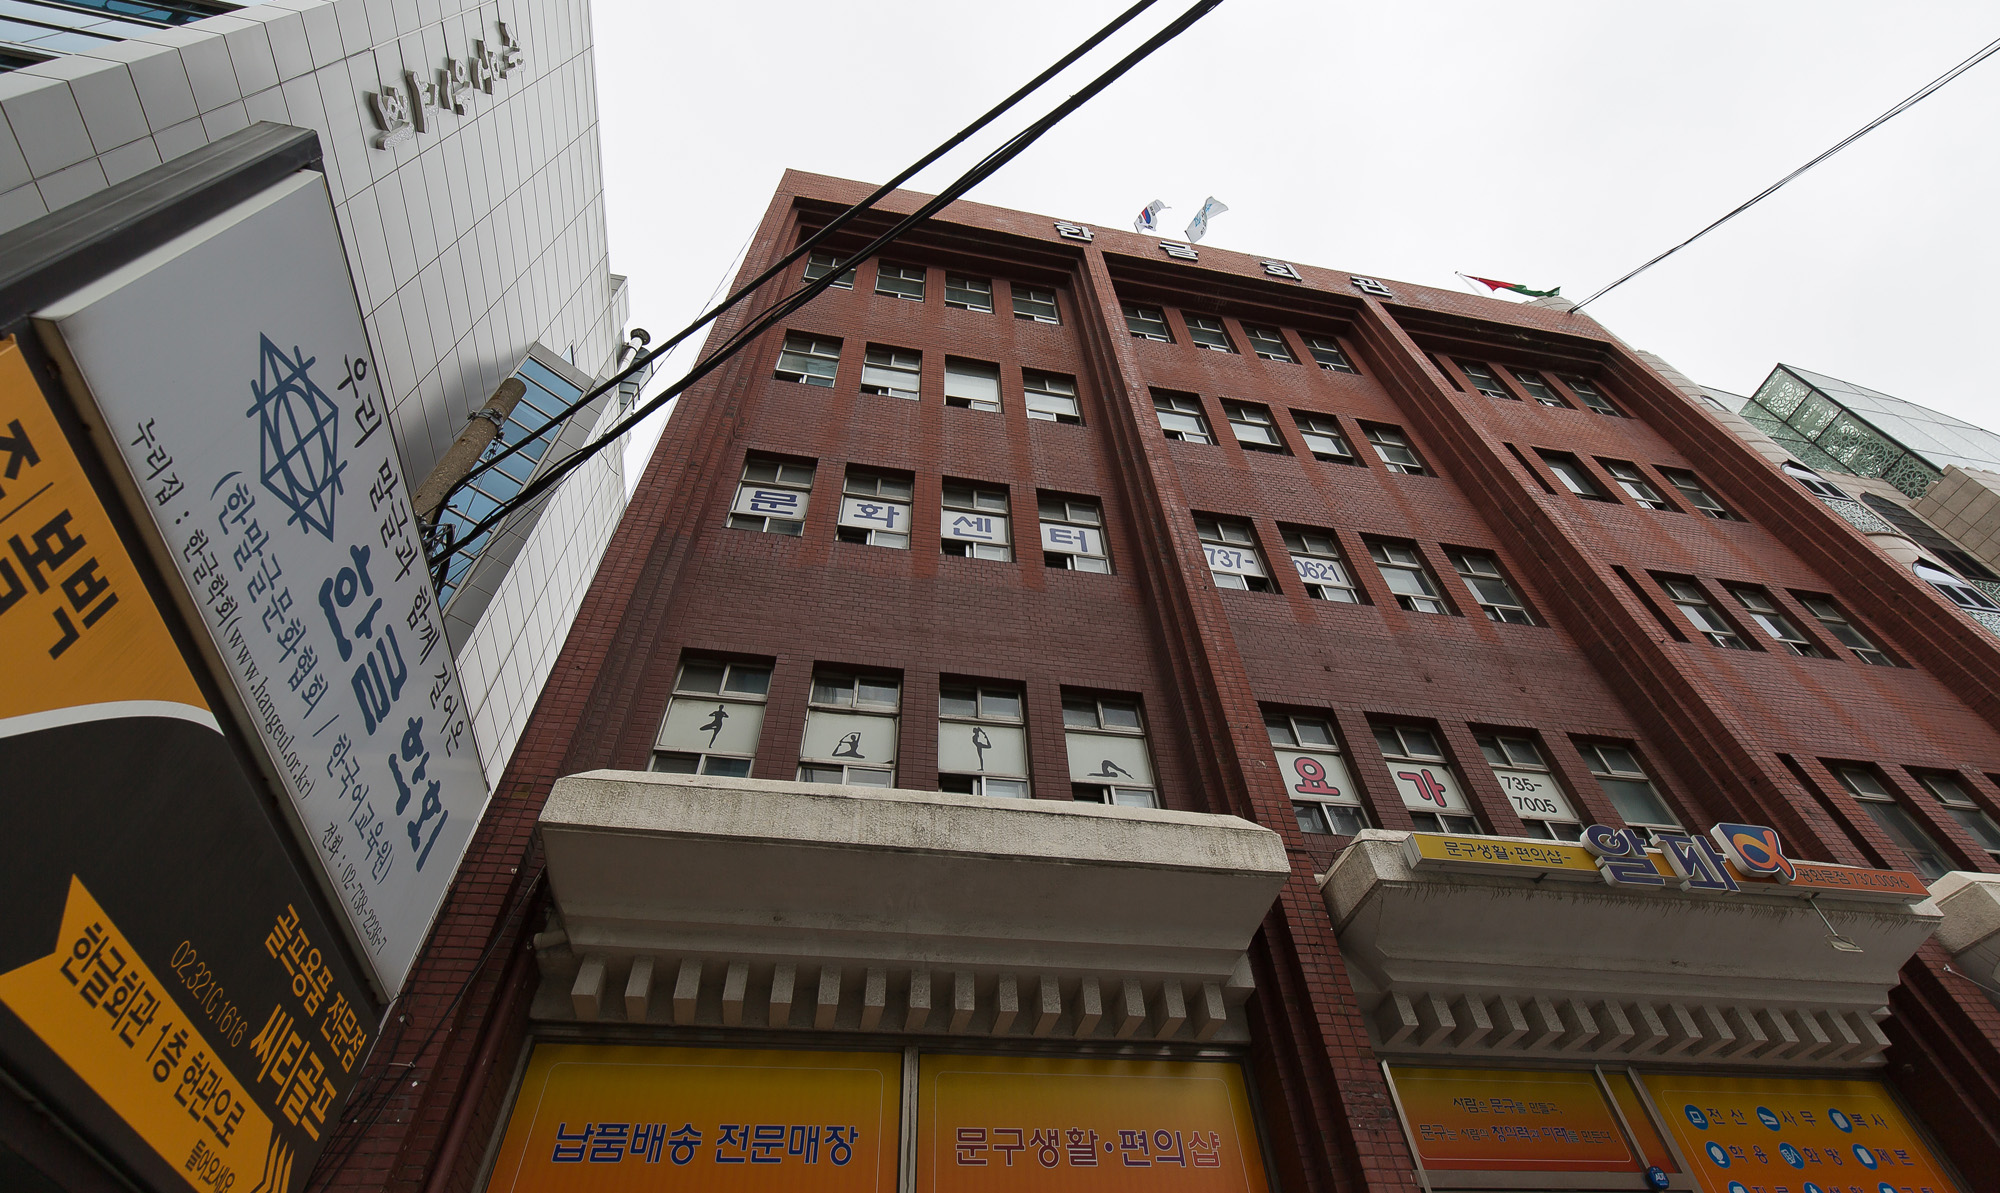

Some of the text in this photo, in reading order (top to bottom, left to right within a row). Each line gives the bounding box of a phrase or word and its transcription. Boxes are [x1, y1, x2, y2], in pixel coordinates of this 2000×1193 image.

[369, 21, 527, 151] 새문안교회
[1054, 220, 1393, 298] 한글회관
[337, 353, 465, 758] 우리 말글과 함께 걸어온
[750, 489, 1088, 554] 문화센터
[130, 417, 185, 507] 누리집
[322, 821, 344, 862] 전화
[209, 470, 395, 886] (한말글문화협회 한국어교육원)
[318, 544, 449, 873] 한글 학회
[1293, 756, 1447, 808] 요가
[1512, 795, 1558, 814] 7005
[1580, 823, 1741, 892] 알파
[1848, 872, 1911, 889] 732.0096
[59, 921, 246, 1149] 한글회관 1층 현관으로
[264, 903, 368, 1074] 골프용품 전문점
[250, 1003, 338, 1142] 씨티골프
[1453, 1096, 1490, 1114] 사람은
[1490, 1097, 1528, 1115] 문구를
[550, 1121, 860, 1166] 납품배송 전문매장
[1419, 1124, 1458, 1142] 문구는
[1491, 1125, 1541, 1143] 창의력과
[1541, 1126, 1580, 1143] 미래를
